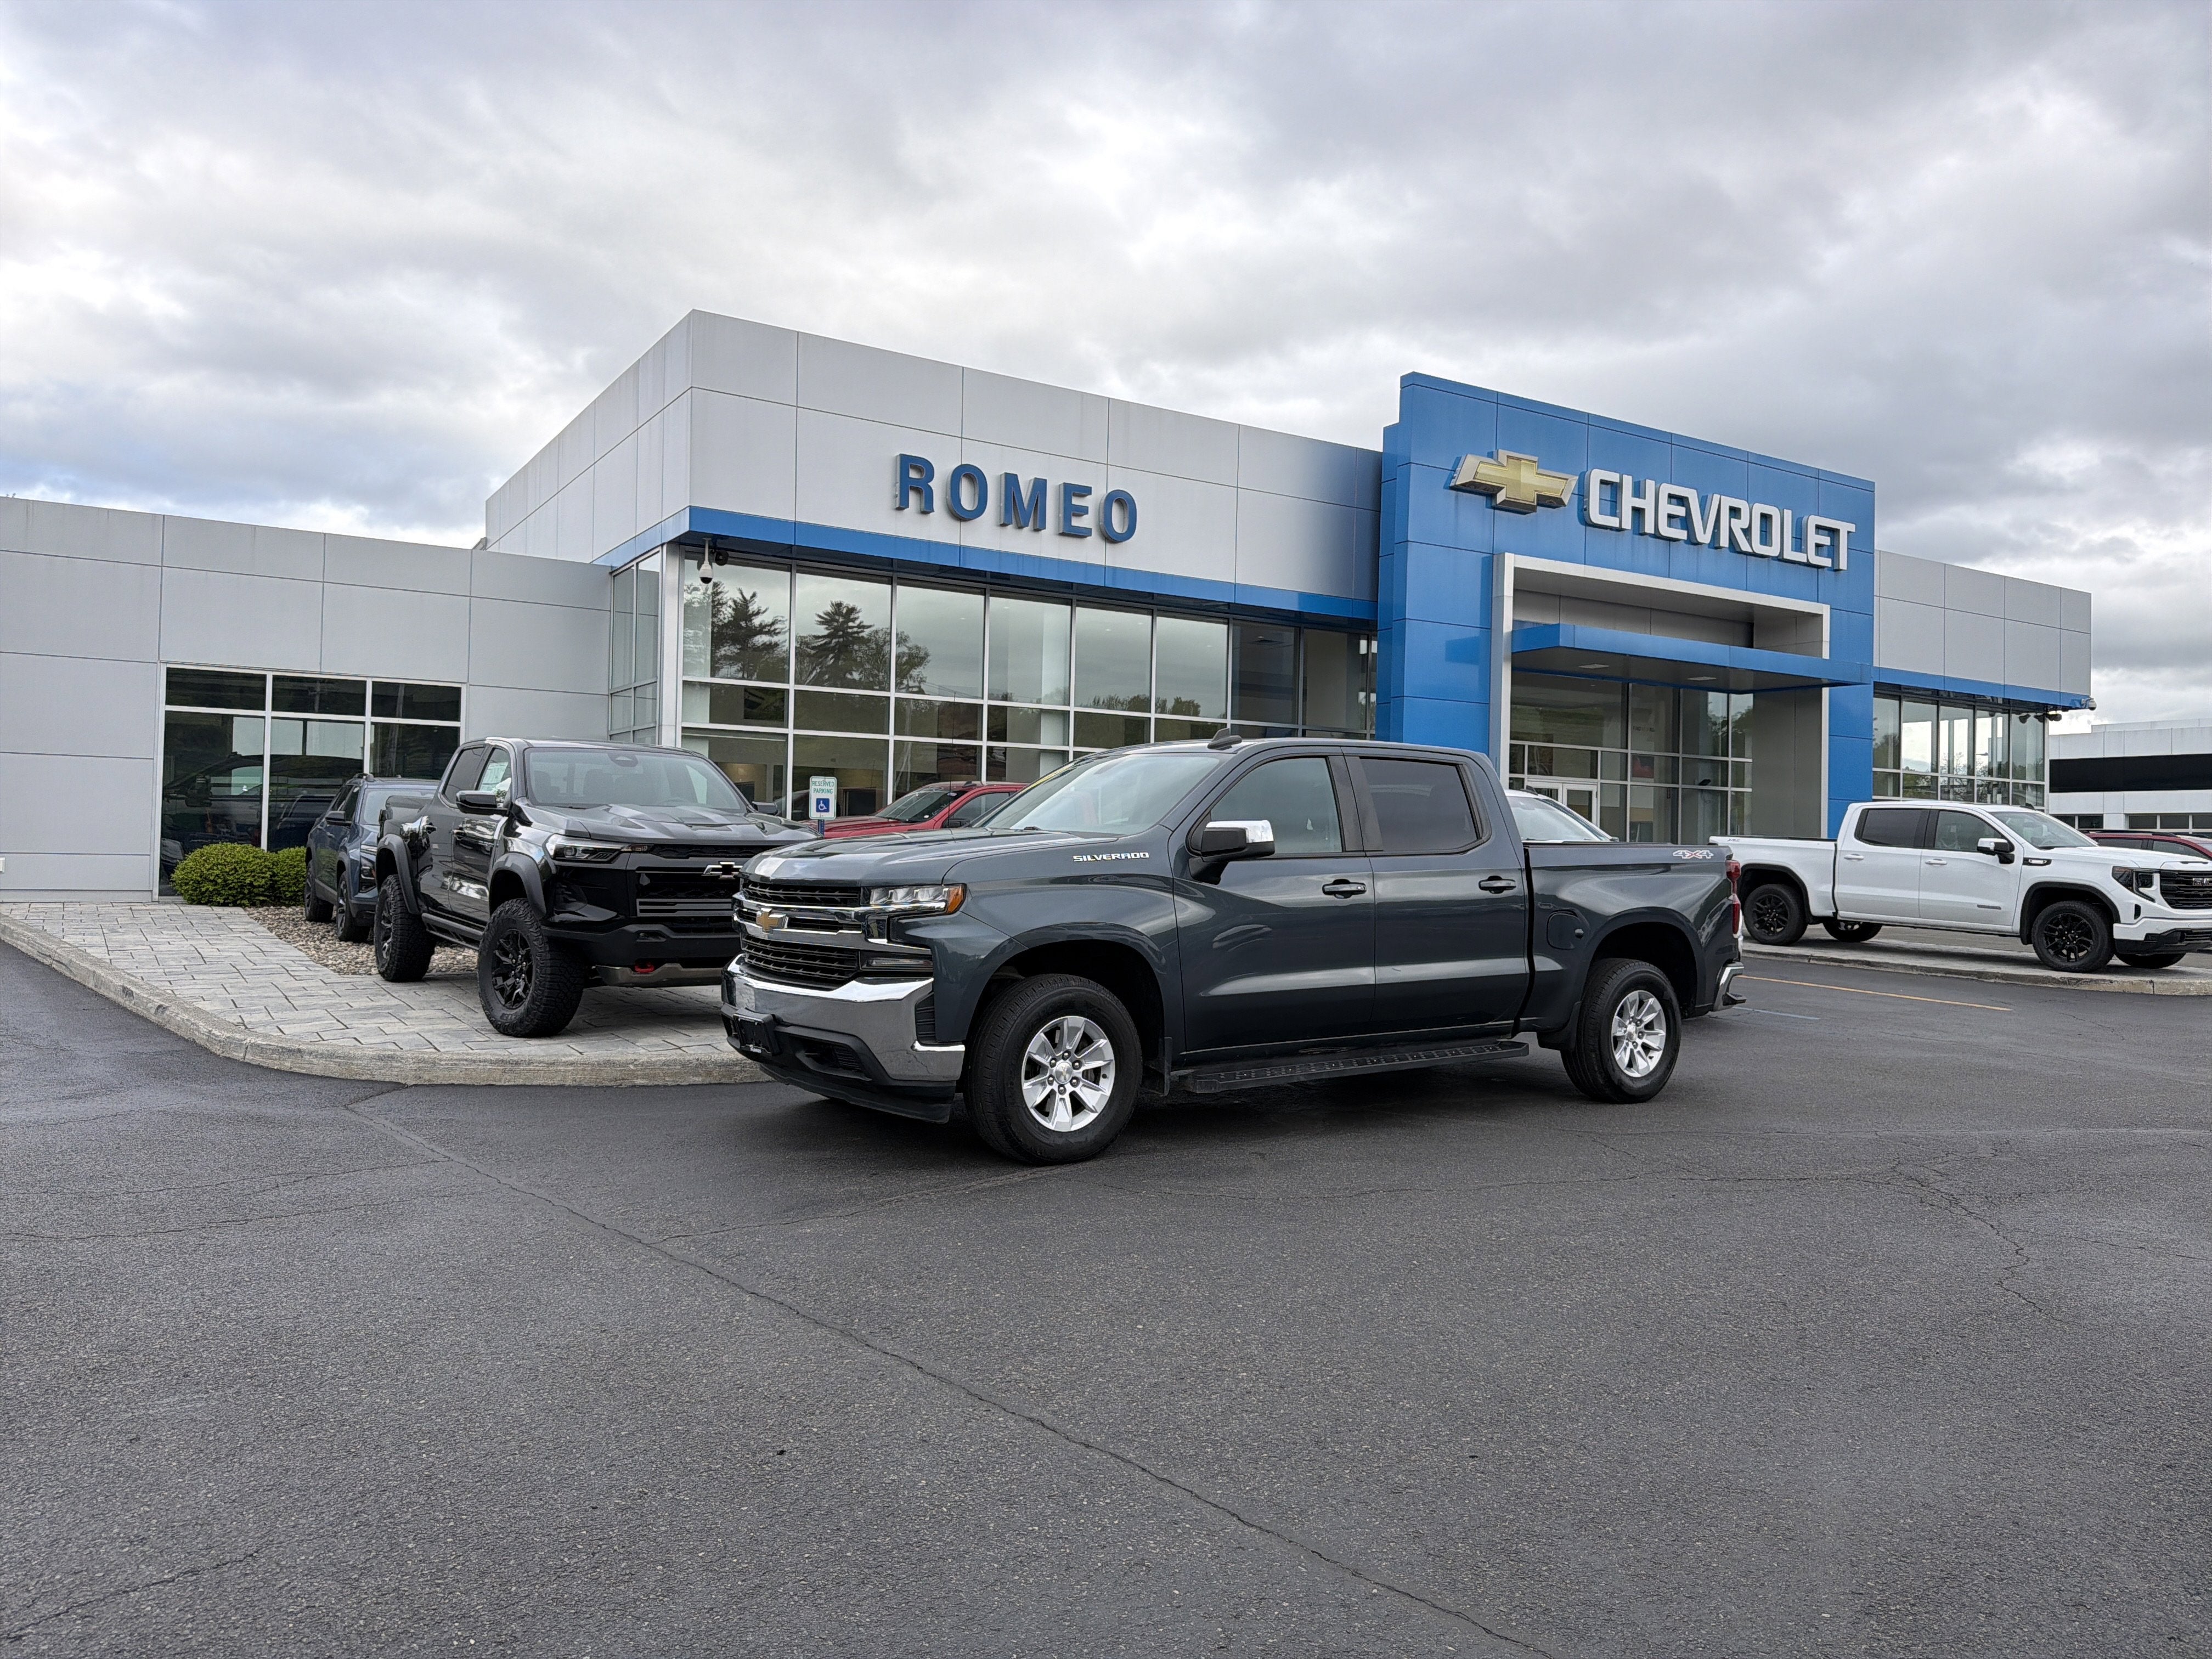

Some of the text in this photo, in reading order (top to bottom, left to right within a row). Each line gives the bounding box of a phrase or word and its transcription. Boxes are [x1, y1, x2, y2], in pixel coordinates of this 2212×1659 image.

[895, 453, 1137, 543] ROMEO
[1585, 469, 1856, 571] CHEVROLET
[1073, 852, 1149, 862] SILVERADO
